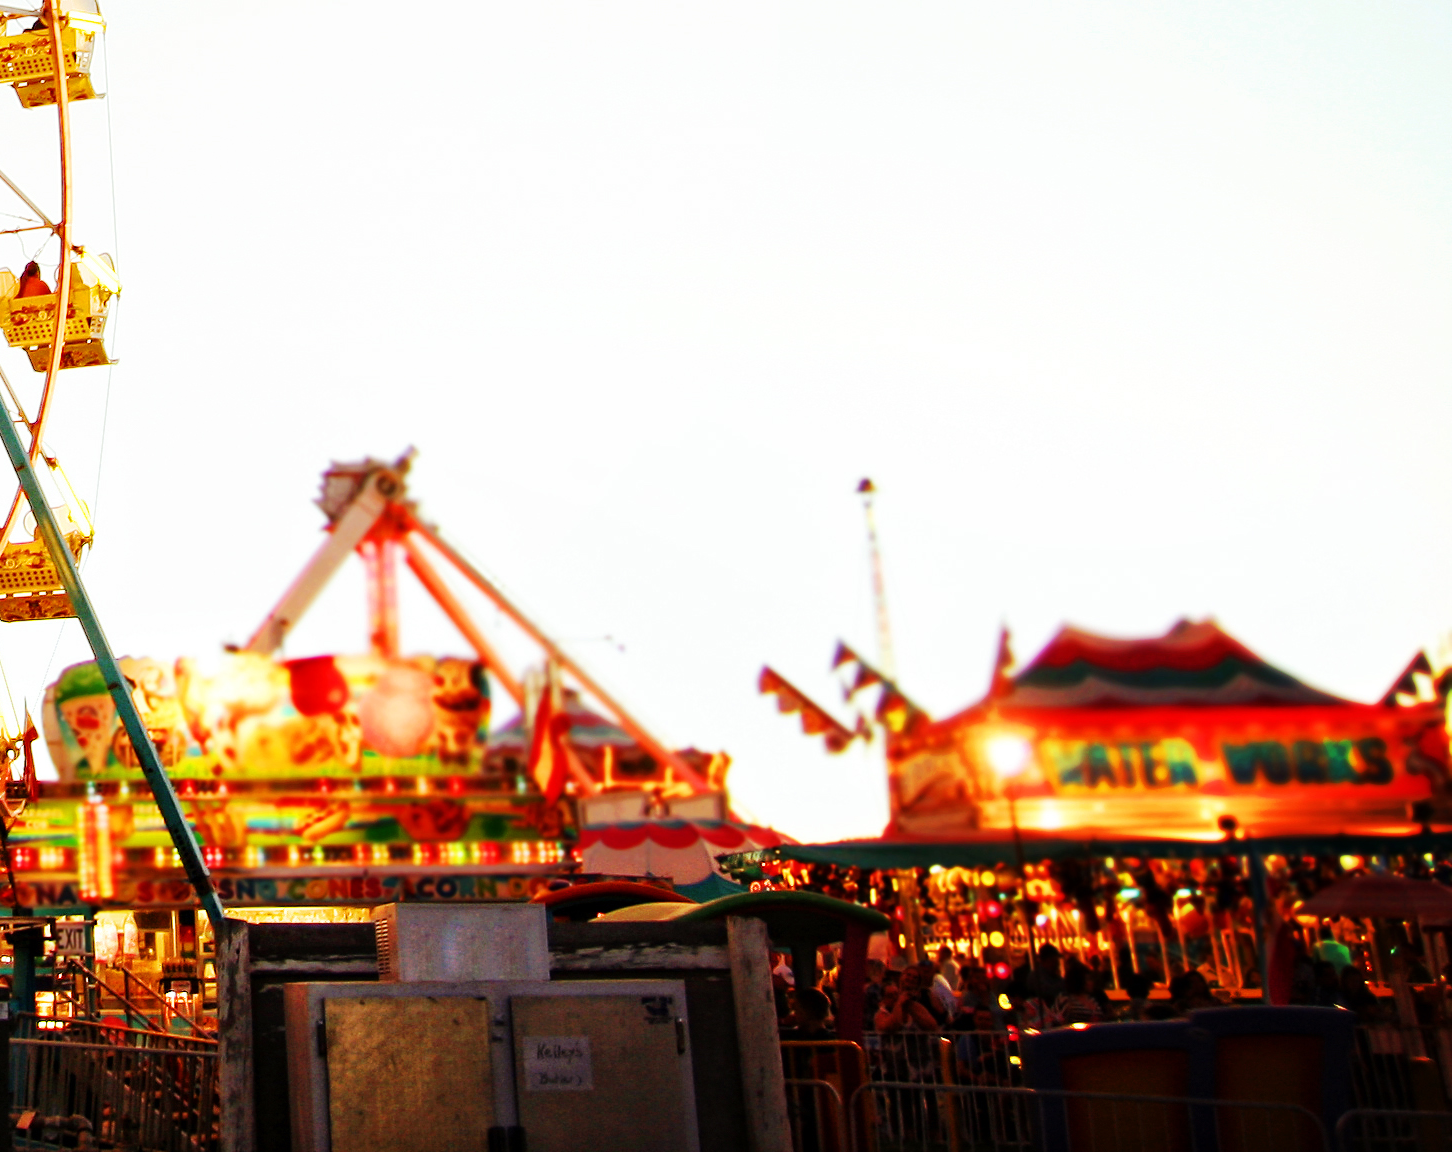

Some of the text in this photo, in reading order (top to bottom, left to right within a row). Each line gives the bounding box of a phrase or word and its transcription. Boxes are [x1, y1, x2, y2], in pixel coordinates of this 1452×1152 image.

[1222, 737, 1394, 785] WORKS
[289, 877, 382, 900] CONES
[417, 876, 497, 899] CORN
[58, 928, 83, 949] EXIT
